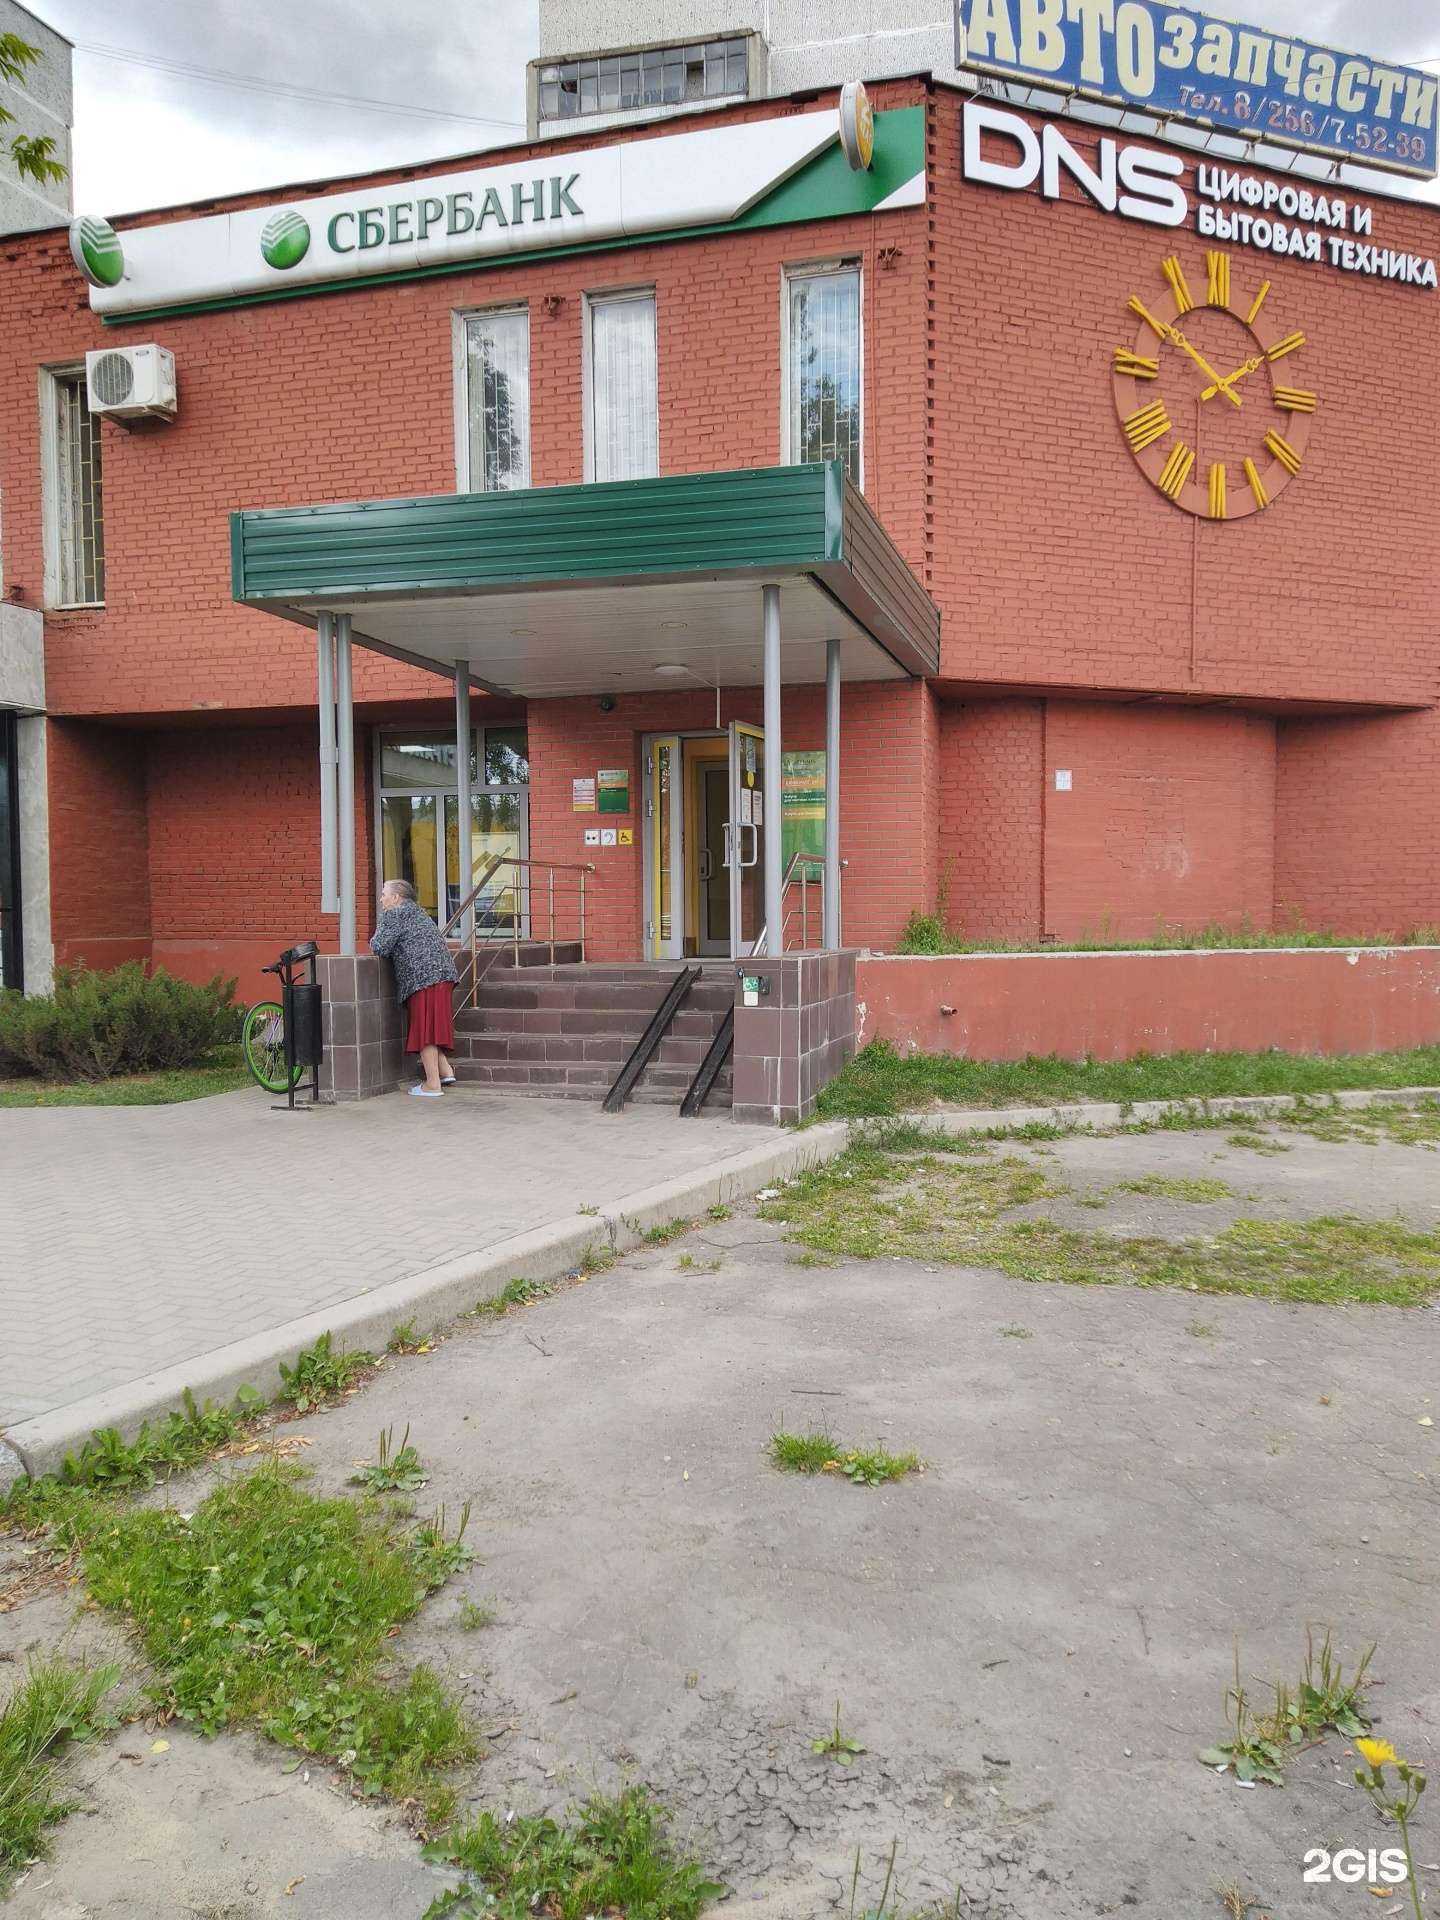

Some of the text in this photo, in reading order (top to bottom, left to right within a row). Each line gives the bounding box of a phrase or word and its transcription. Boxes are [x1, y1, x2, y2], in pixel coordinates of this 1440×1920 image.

[1179, 85, 1228, 115] Тел.
[963, 102, 1188, 227] DNS
[1197, 164, 1373, 236] ЦИФРОВАЯ И
[327, 172, 584, 254] СБЕРБАНК
[1197, 204, 1438, 288] БЫТОВАЯ ТЕХНИКА
